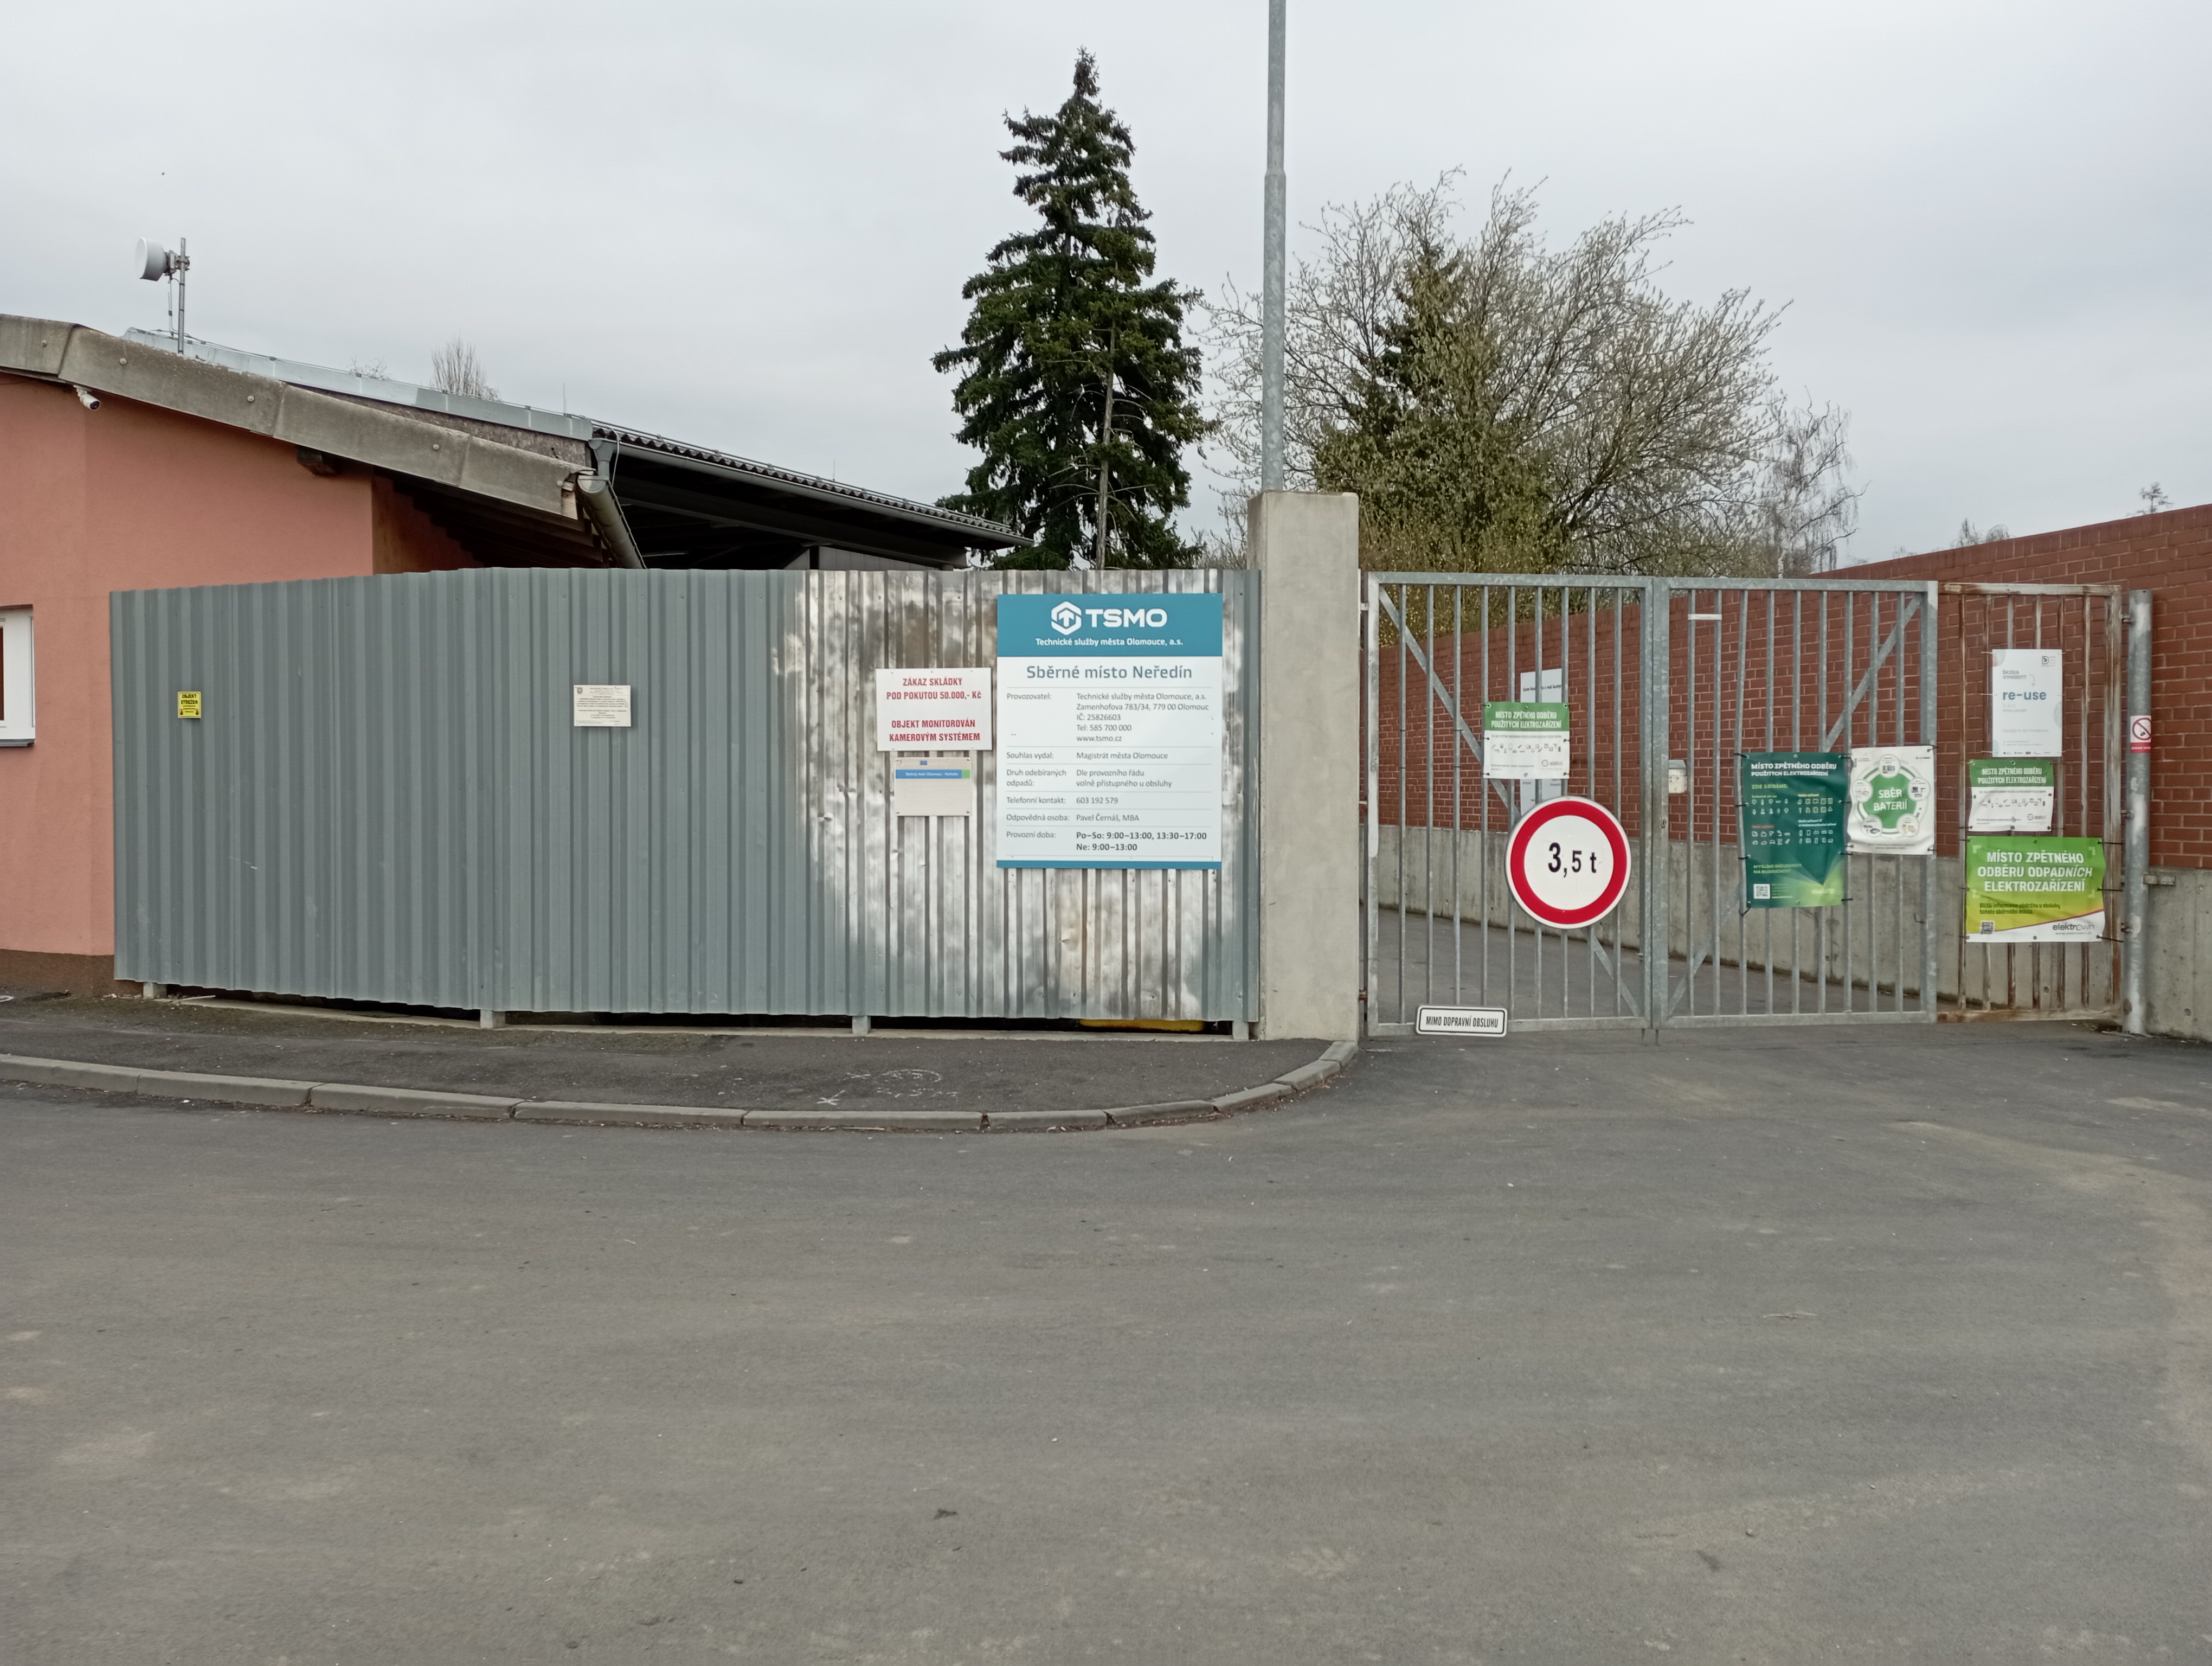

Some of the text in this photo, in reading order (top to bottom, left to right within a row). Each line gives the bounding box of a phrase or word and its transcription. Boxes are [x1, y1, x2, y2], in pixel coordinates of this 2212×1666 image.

[1085, 608, 1168, 628] TSMO
[1036, 638, 1072, 646] Technické
[1074, 638, 1099, 646] služby
[1101, 638, 1125, 646] města
[1127, 638, 1167, 646] Olomouce,
[1026, 665, 1192, 678] Sběrné místo Neředín
[903, 676, 963, 686] ZÁKAZ SKLÁDKY
[886, 691, 901, 700] POD
[904, 691, 937, 700] POKUTOU
[972, 690, 981, 699] Kč
[1111, 693, 1132, 701] služby
[2003, 691, 2047, 700] re-use
[1495, 710, 1512, 719] MÍSTO
[1536, 710, 1557, 719] ODBĚRU
[922, 718, 975, 728] MONITOROVÁN
[1491, 719, 1561, 728] POUŽITÝCH ELEKTROZAŘÍZENÍ
[889, 731, 980, 741] KAMEROVÝM SYSTÉMEM
[1034, 752, 1054, 760] vydal:
[1025, 769, 1066, 777] odebíraných
[1089, 769, 1127, 777] provozního
[1982, 766, 2042, 775] MÍSTO ZPĚTNÉHO ODBĚRU
[1007, 779, 1034, 787] odpadů:
[2005, 776, 2046, 784] ELEKTROZAŘÍZENÍ
[1878, 787, 1902, 798] SBĚR
[1874, 799, 1907, 811] BATERIÍ
[1548, 842, 1597, 878] 3,5 t
[1987, 849, 2084, 863] MÍSTO ZPĚTNÉHO
[1977, 864, 2093, 877] ODBĚRU ODPADNÍCH
[1984, 879, 2085, 892] ELEKTROZAŘÍZENÍ
[1426, 1015, 1498, 1028] MIMO DOPRAVNÍ OBSLUHU
